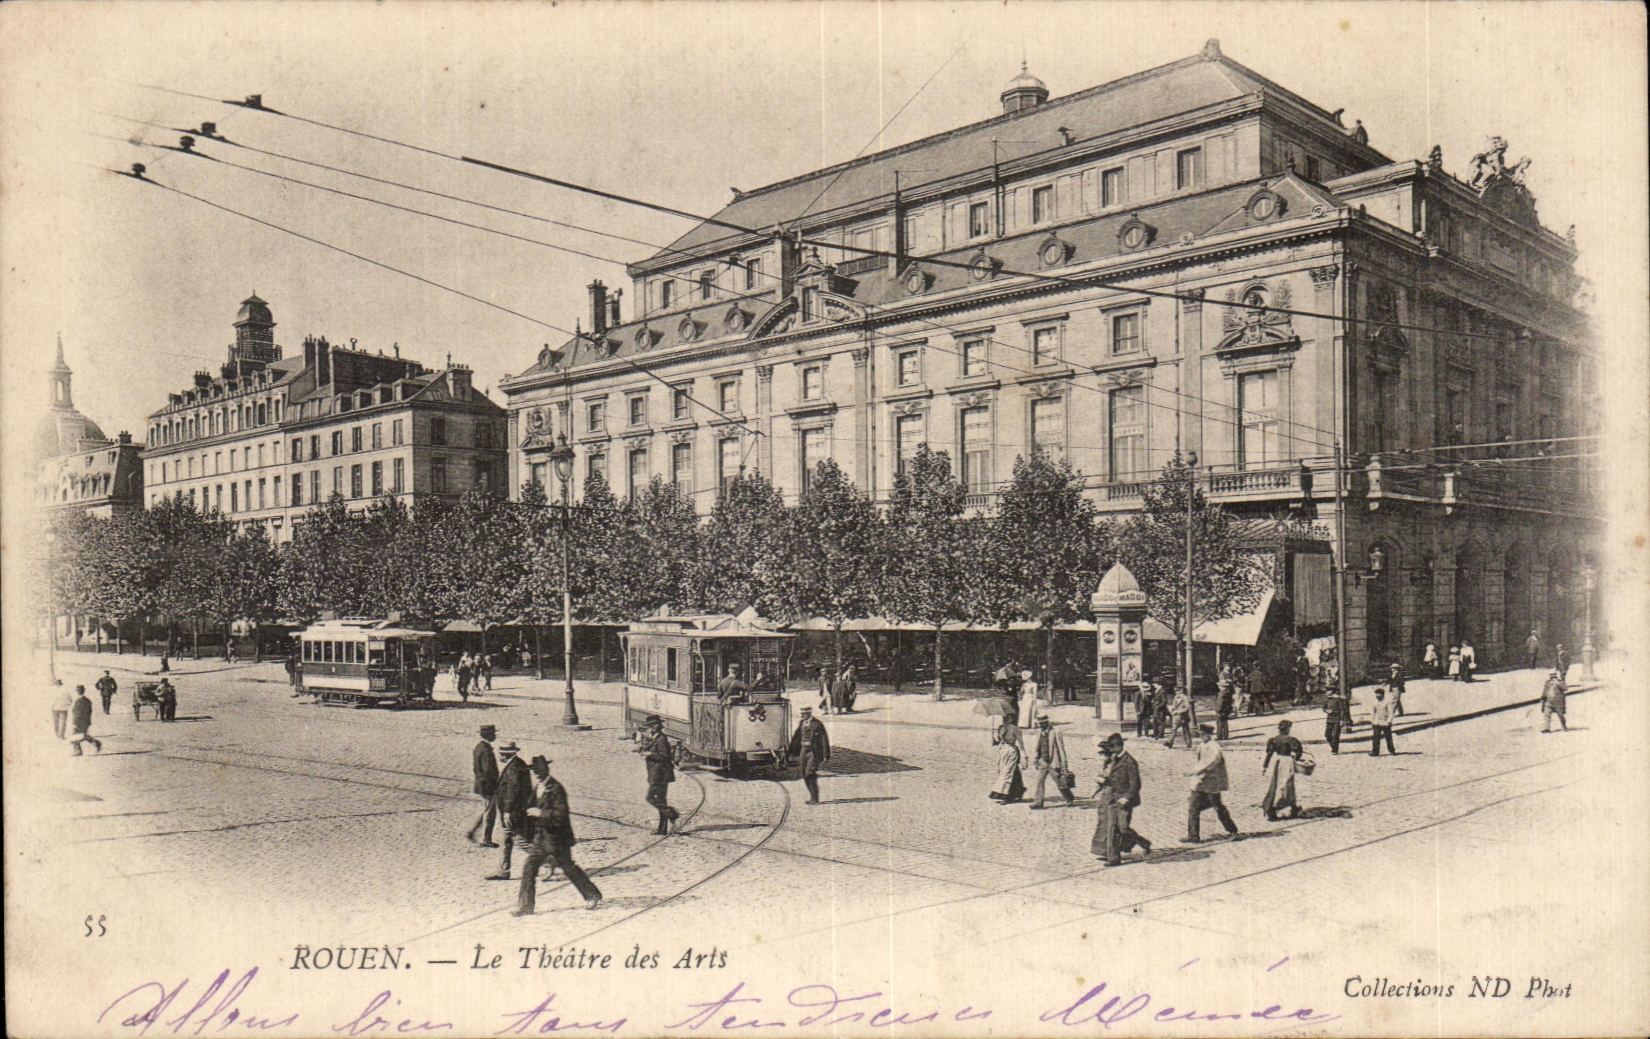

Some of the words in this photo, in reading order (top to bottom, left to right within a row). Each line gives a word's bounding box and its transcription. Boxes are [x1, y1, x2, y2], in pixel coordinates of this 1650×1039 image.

[1119, 593, 1145, 601] MAGGI
[97, 965, 299, 1036] Allons
[332, 989, 454, 1036] bien
